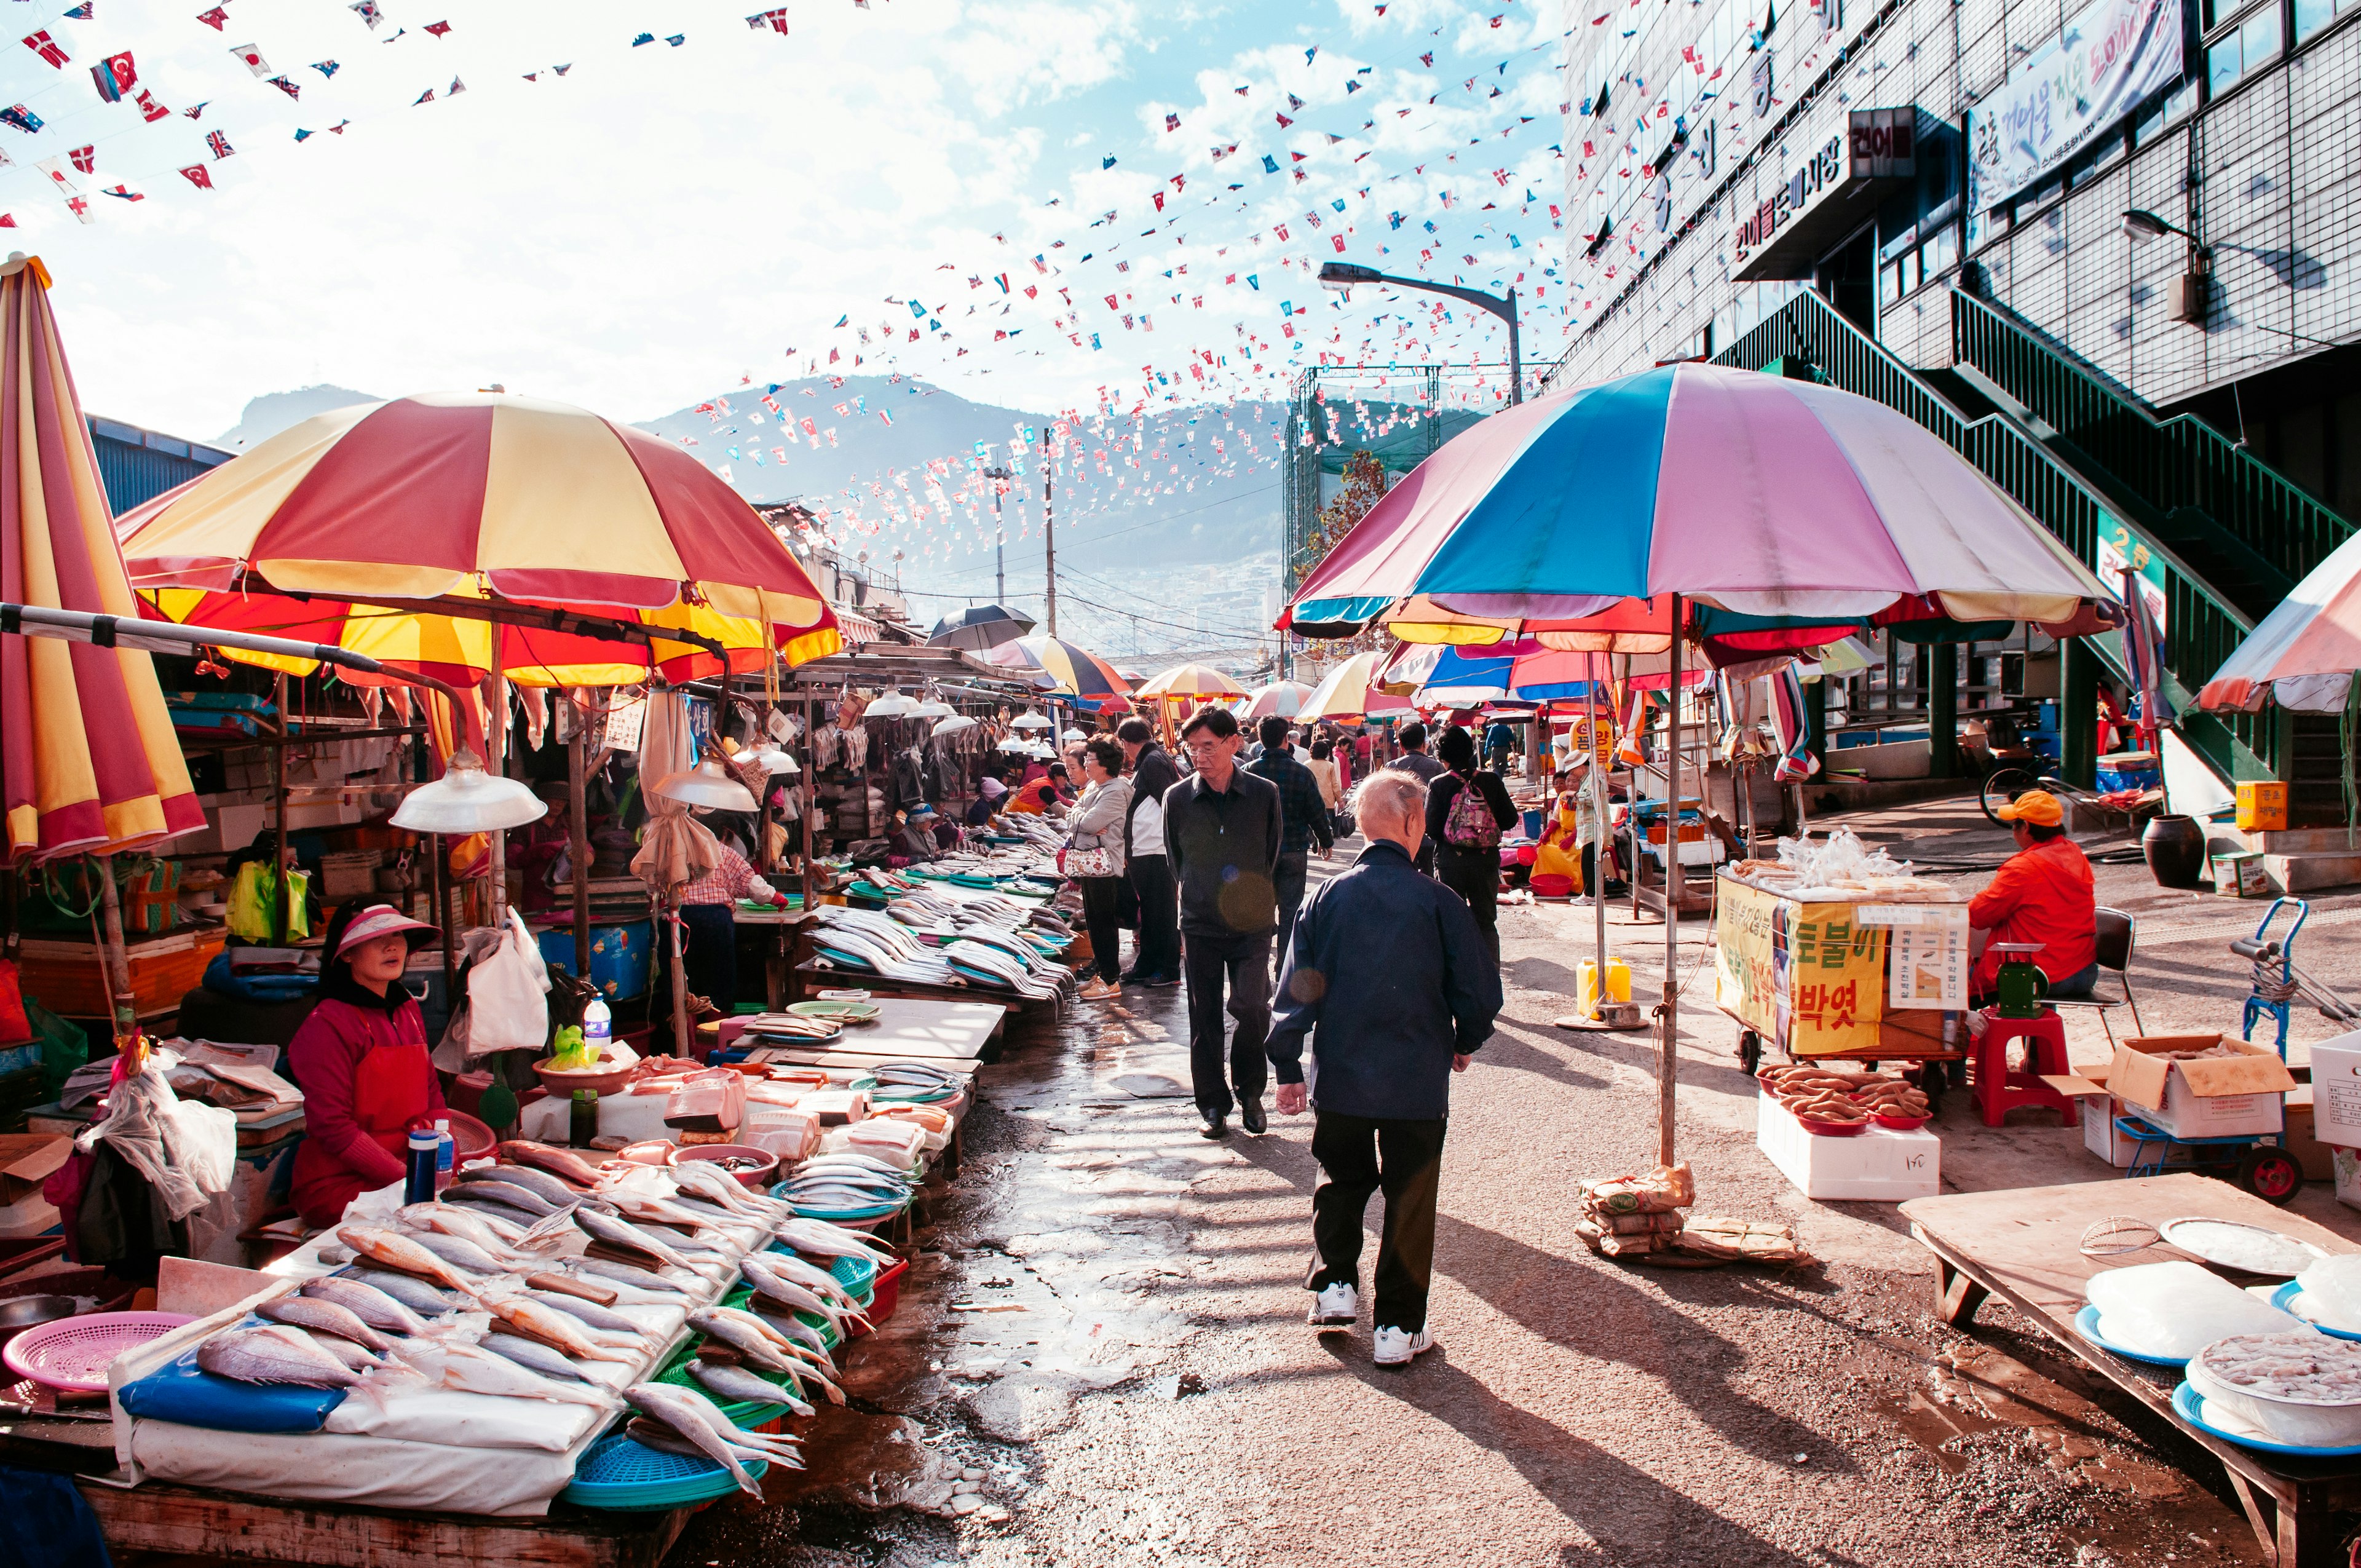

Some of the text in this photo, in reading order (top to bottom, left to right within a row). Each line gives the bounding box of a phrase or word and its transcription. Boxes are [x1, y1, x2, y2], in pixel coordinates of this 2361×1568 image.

[1853, 126, 1911, 159] 건어물
[2102, 552, 2162, 619] 건물
[1797, 921, 1877, 968] 토불이
